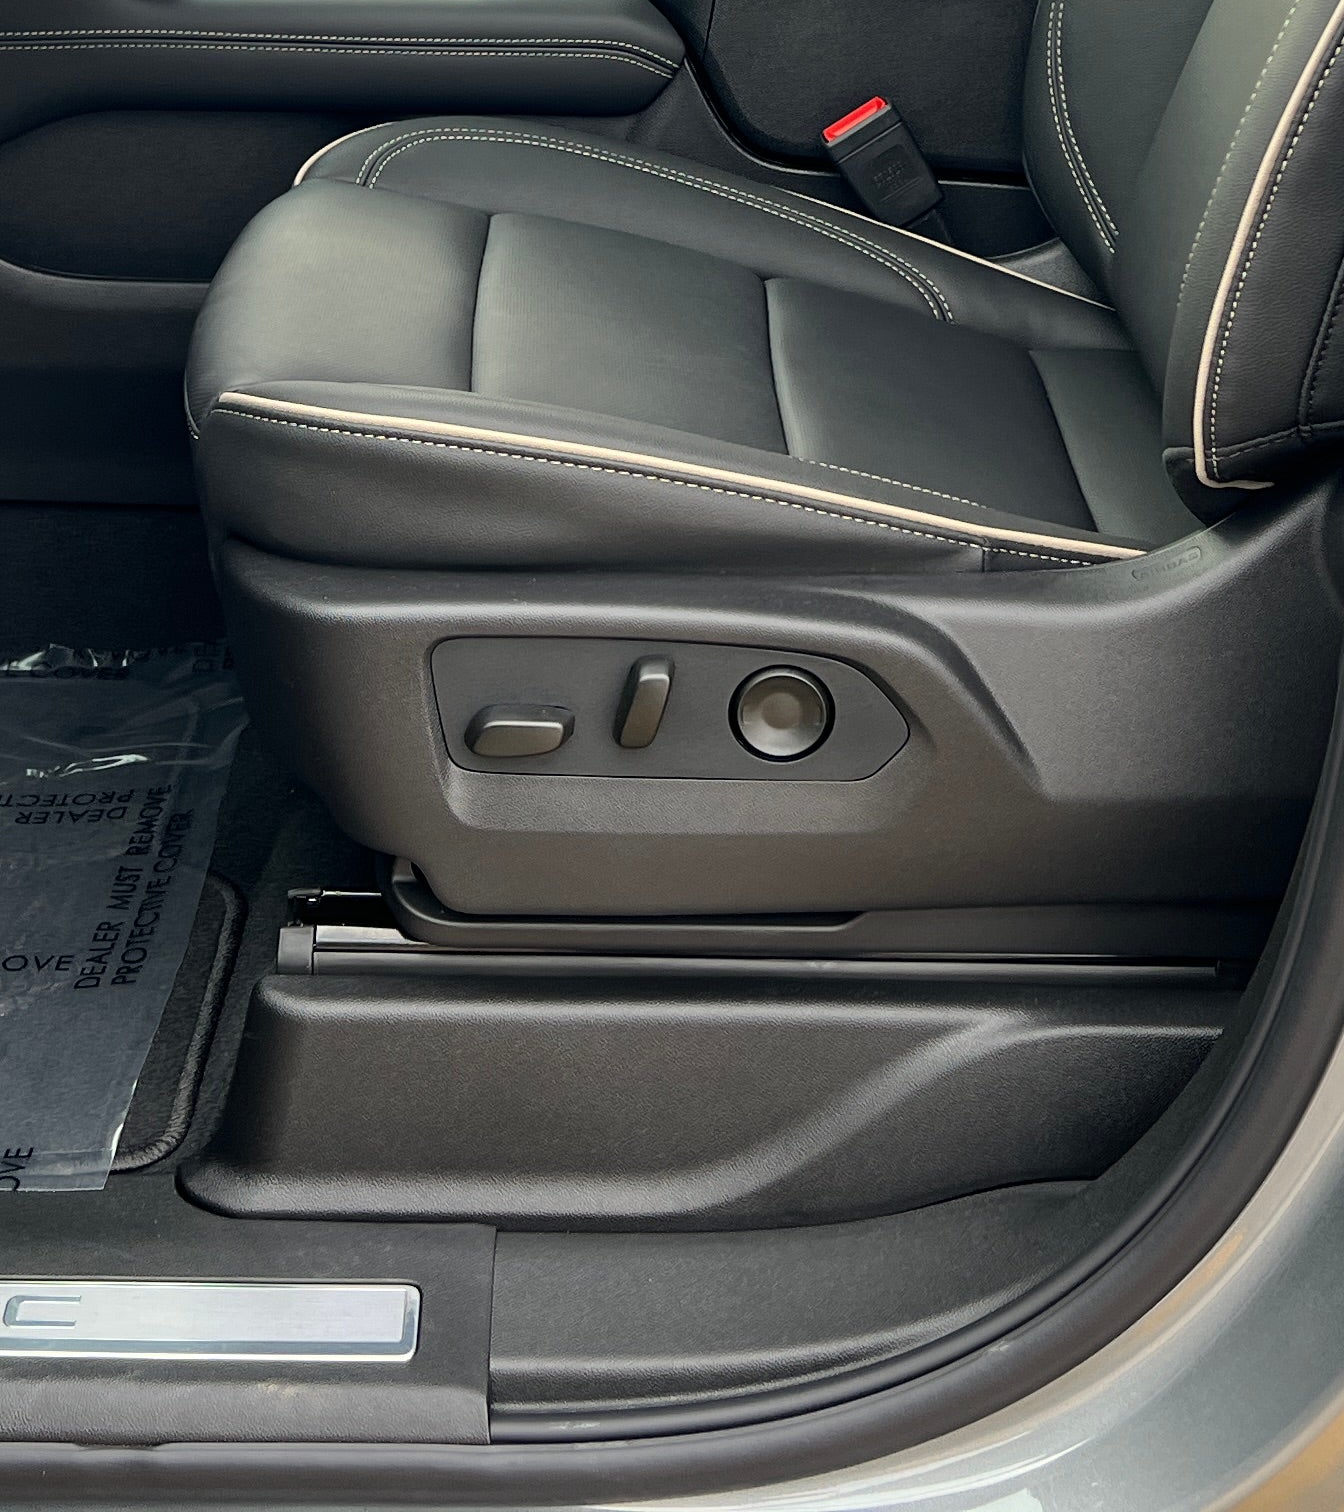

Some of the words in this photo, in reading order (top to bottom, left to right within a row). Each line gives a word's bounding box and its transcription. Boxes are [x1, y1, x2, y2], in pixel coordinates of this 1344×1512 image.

[13, 805, 127, 825] DEALER
[124, 784, 172, 856] REMOVE
[106, 865, 144, 911] MUST
[73, 920, 125, 990] DEALER
[111, 875, 172, 986] PROTECTIVE
